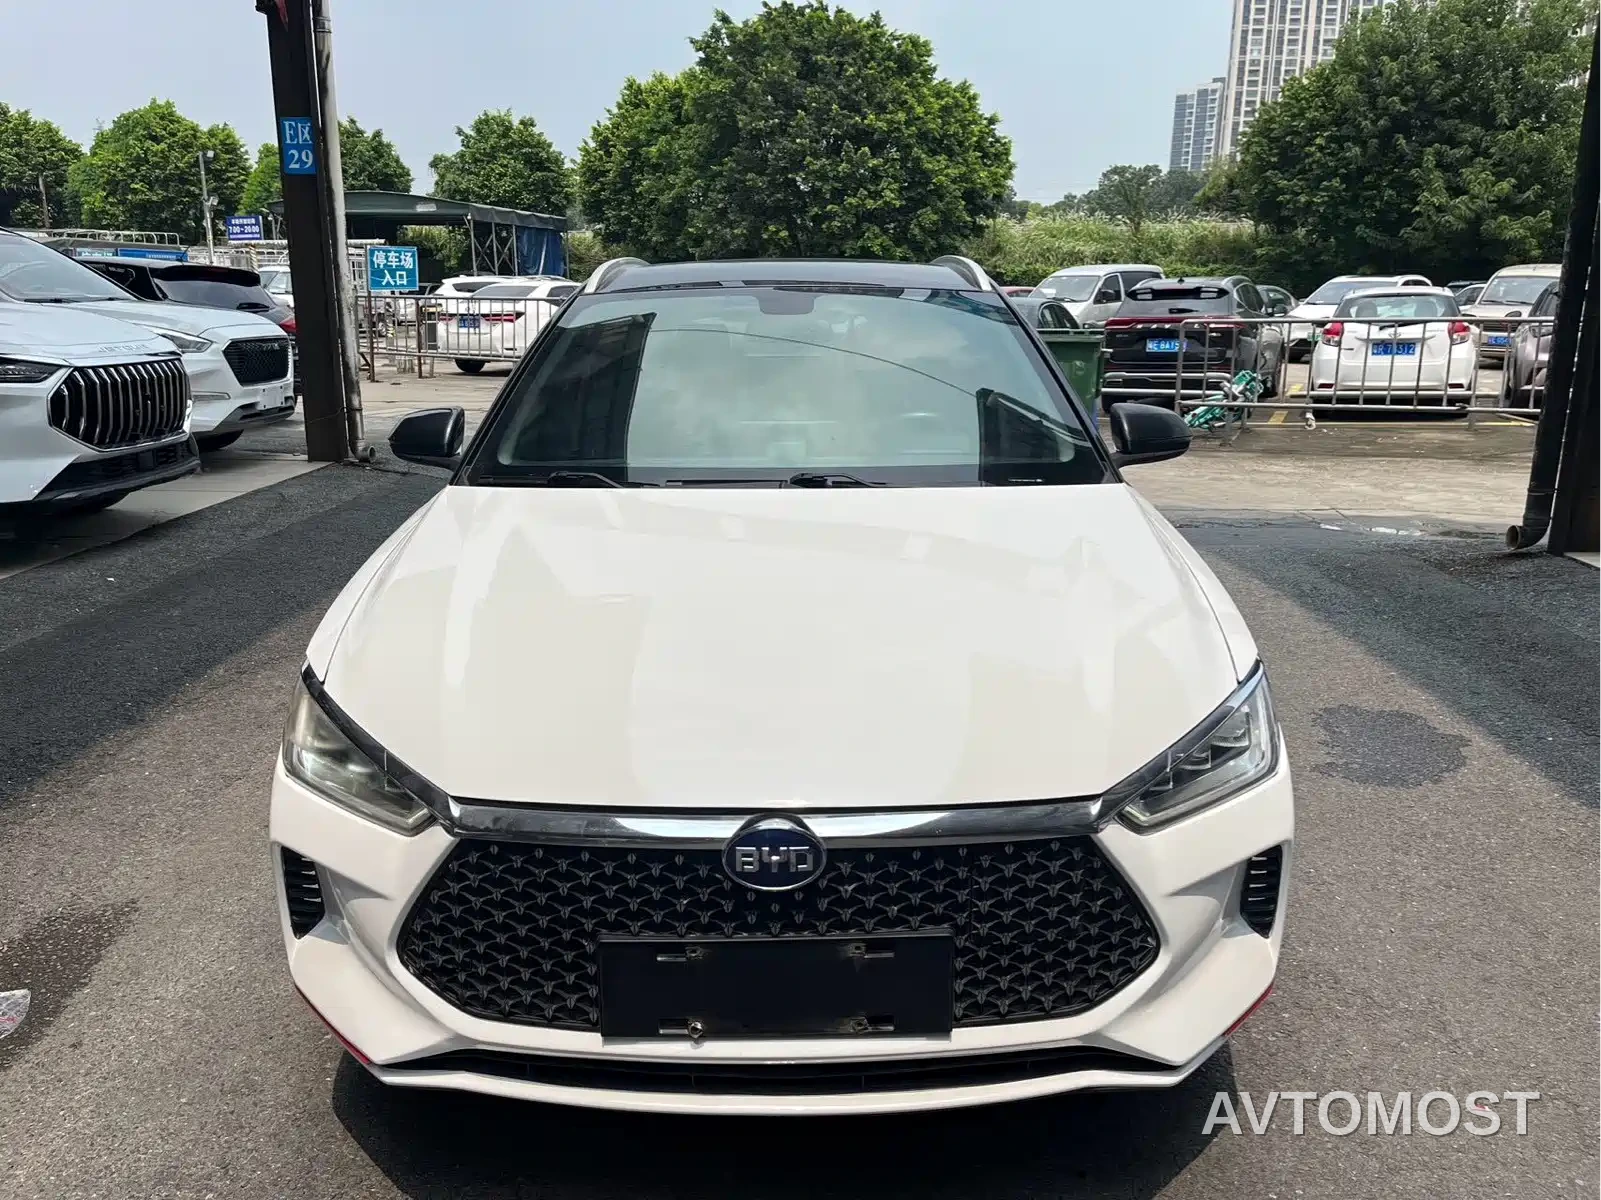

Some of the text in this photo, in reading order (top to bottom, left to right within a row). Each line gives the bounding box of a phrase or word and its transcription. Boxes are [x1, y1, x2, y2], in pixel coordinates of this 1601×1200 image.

[283, 120, 313, 144] E区
[288, 150, 313, 169] 29
[373, 250, 414, 269] 停车场
[382, 270, 407, 286] 入口
[735, 846, 814, 873] BYD
